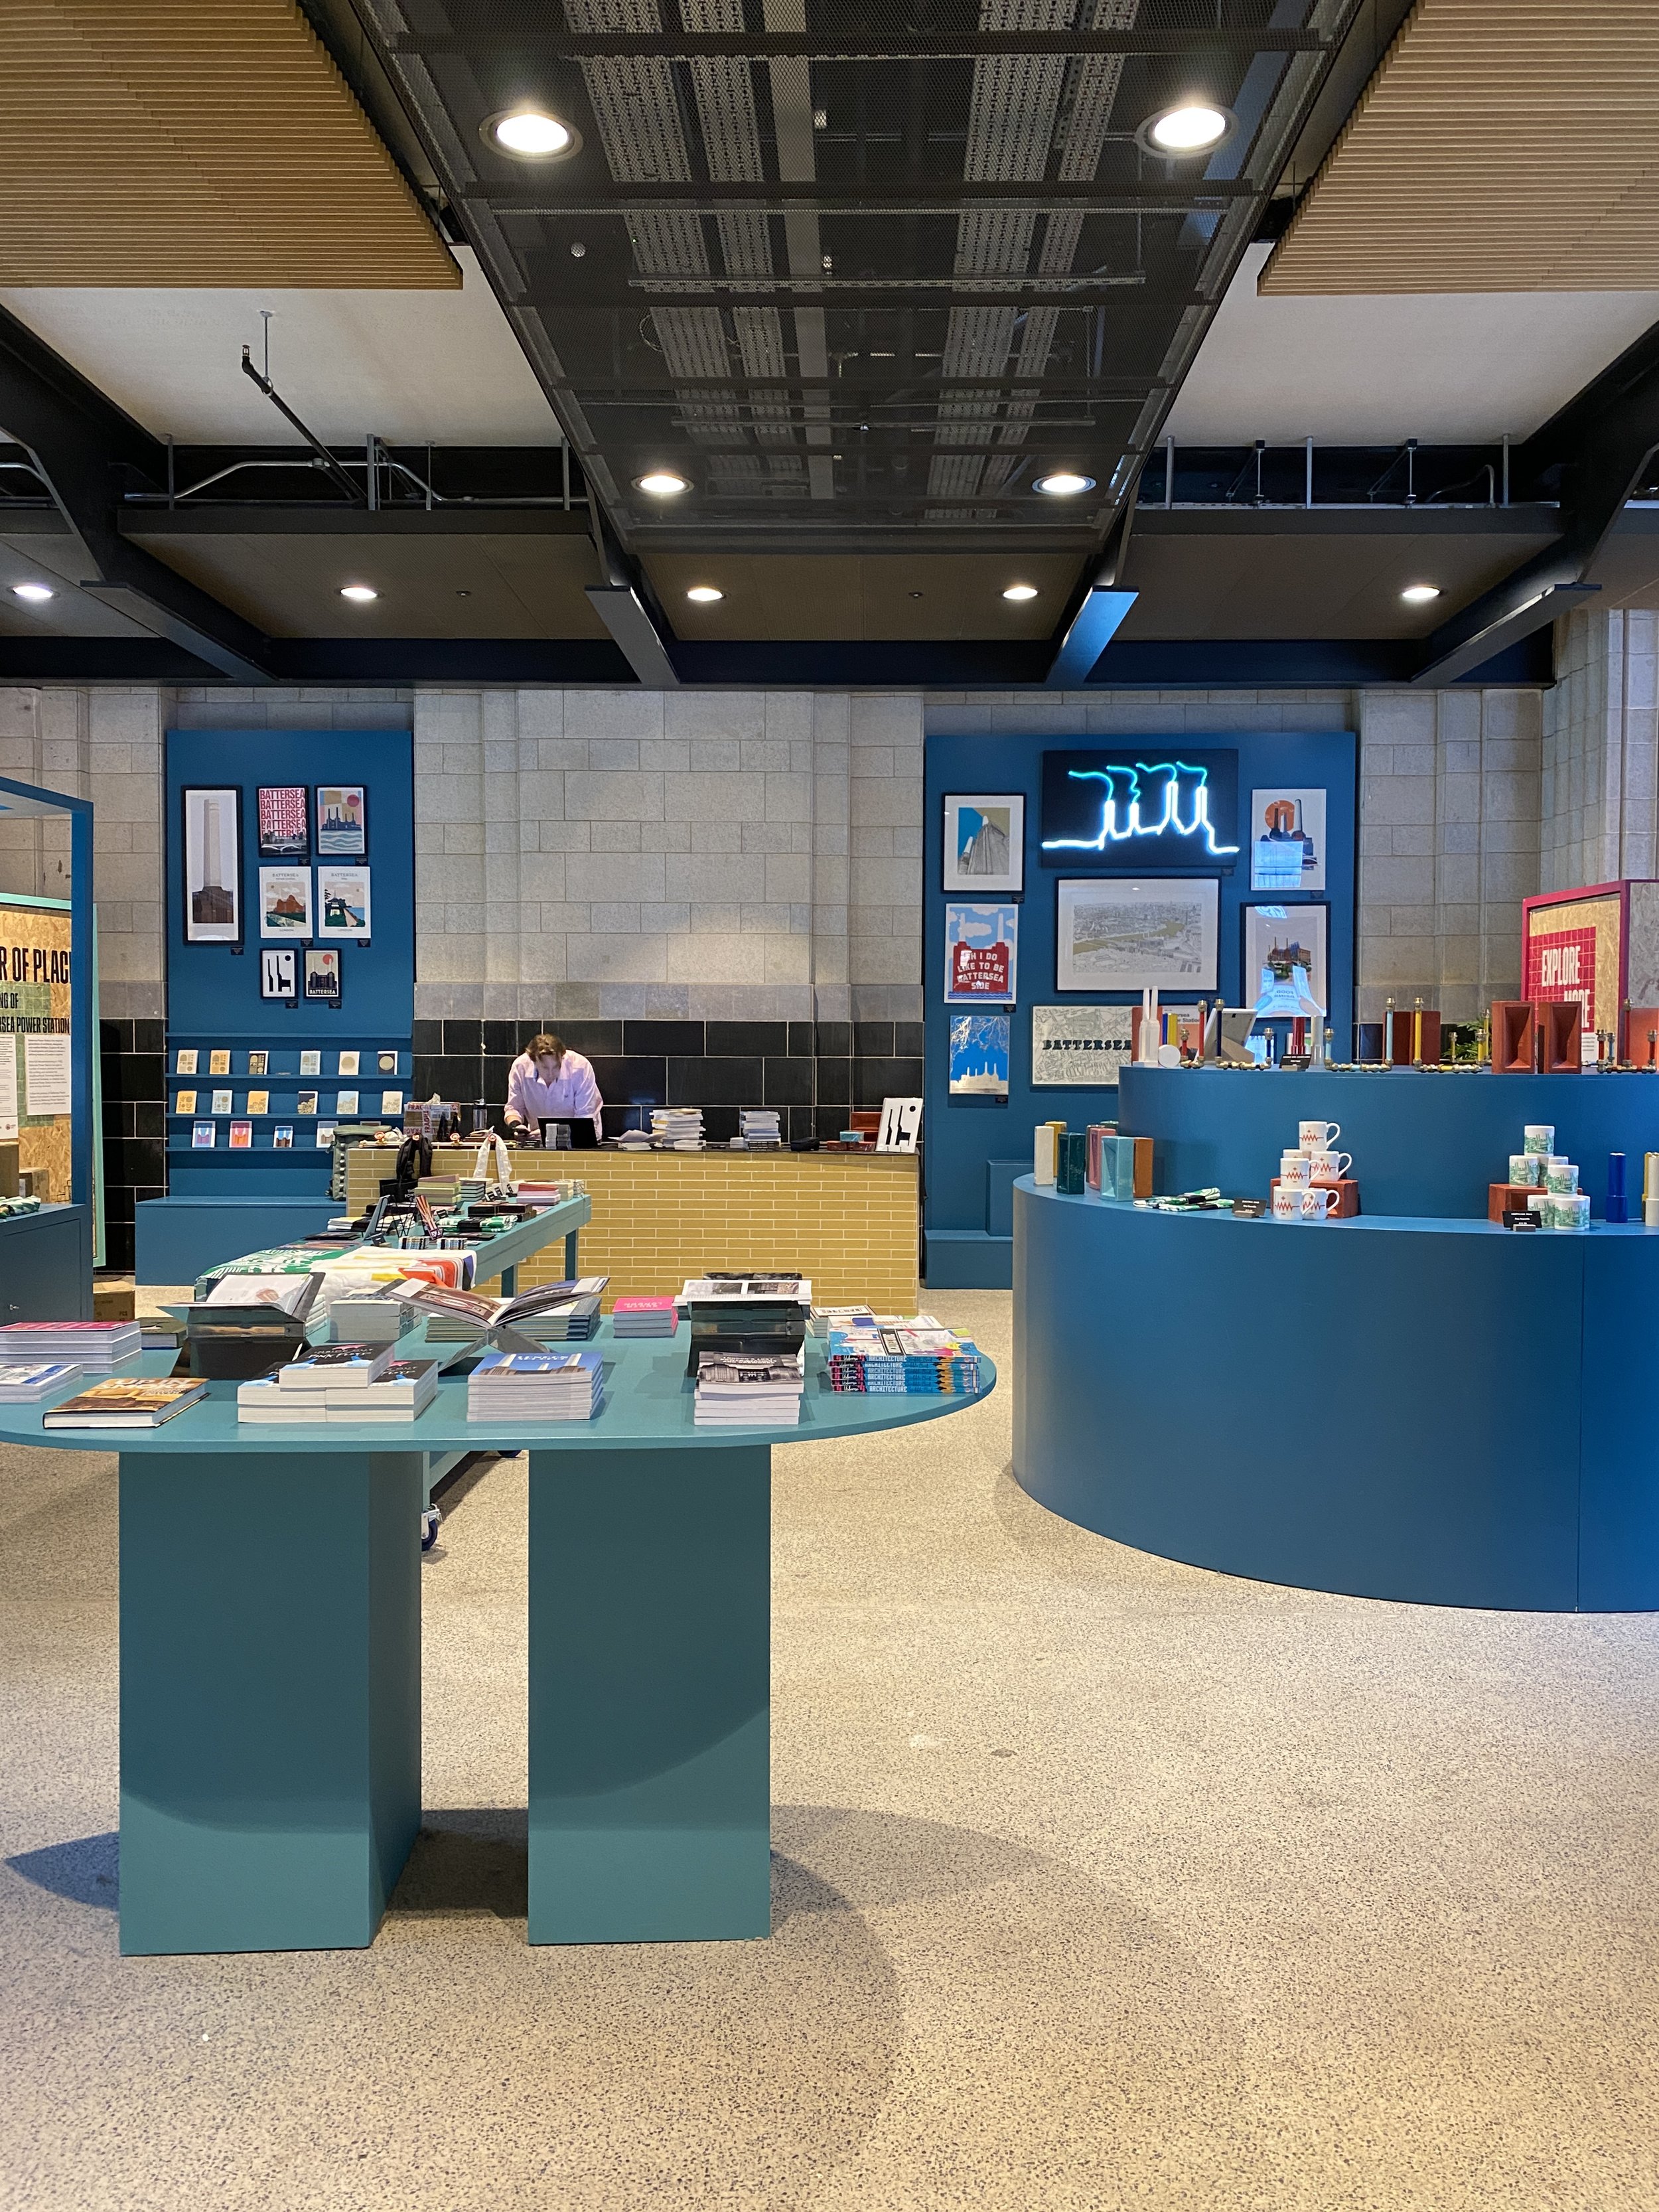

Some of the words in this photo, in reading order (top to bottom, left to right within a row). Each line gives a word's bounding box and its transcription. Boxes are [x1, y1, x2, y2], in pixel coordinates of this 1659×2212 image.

[260, 789, 305, 799] BATTERSEA
[261, 799, 305, 809] BATTERSEA
[261, 809, 305, 820] BATTERSEA
[261, 819, 307, 830] BATTERSEA
[12, 947, 29, 982] OF
[33, 949, 71, 984] PLAC
[993, 964, 1004, 973] BE
[1542, 946, 1581, 987] EXPLORE
[957, 972, 1004, 983] BATTERSEA
[10, 993, 19, 1009] OF
[1564, 989, 1590, 1028] RE
[17, 1017, 40, 1033] POWER
[42, 1017, 70, 1033] STATION
[1043, 1039, 1131, 1050] BATTERSEA
